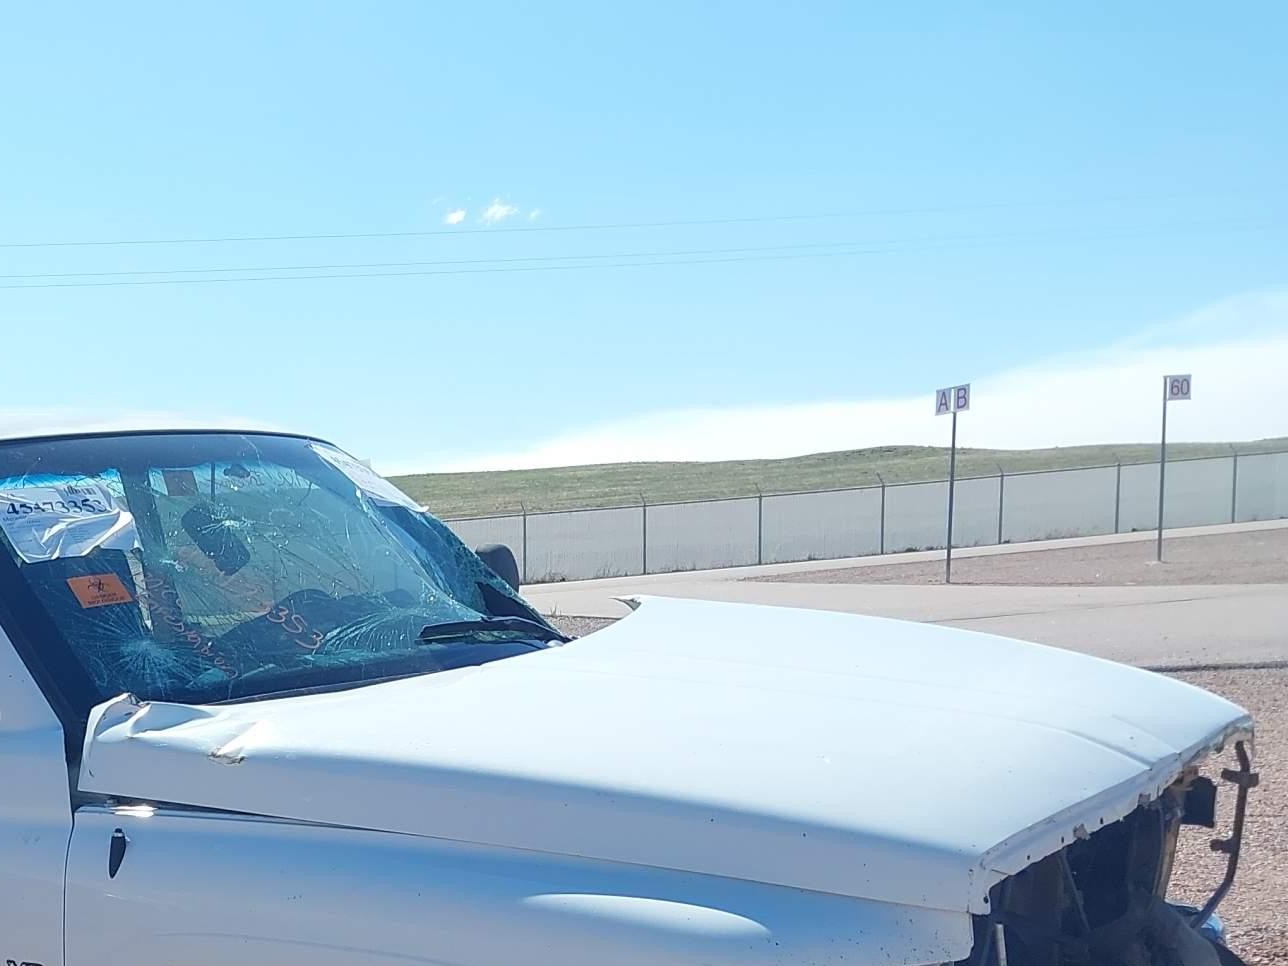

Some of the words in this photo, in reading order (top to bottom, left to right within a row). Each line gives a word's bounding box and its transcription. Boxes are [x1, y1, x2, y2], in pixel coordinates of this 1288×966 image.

[956, 387, 967, 409] B
[1171, 378, 1190, 396] 60
[937, 391, 949, 413] A
